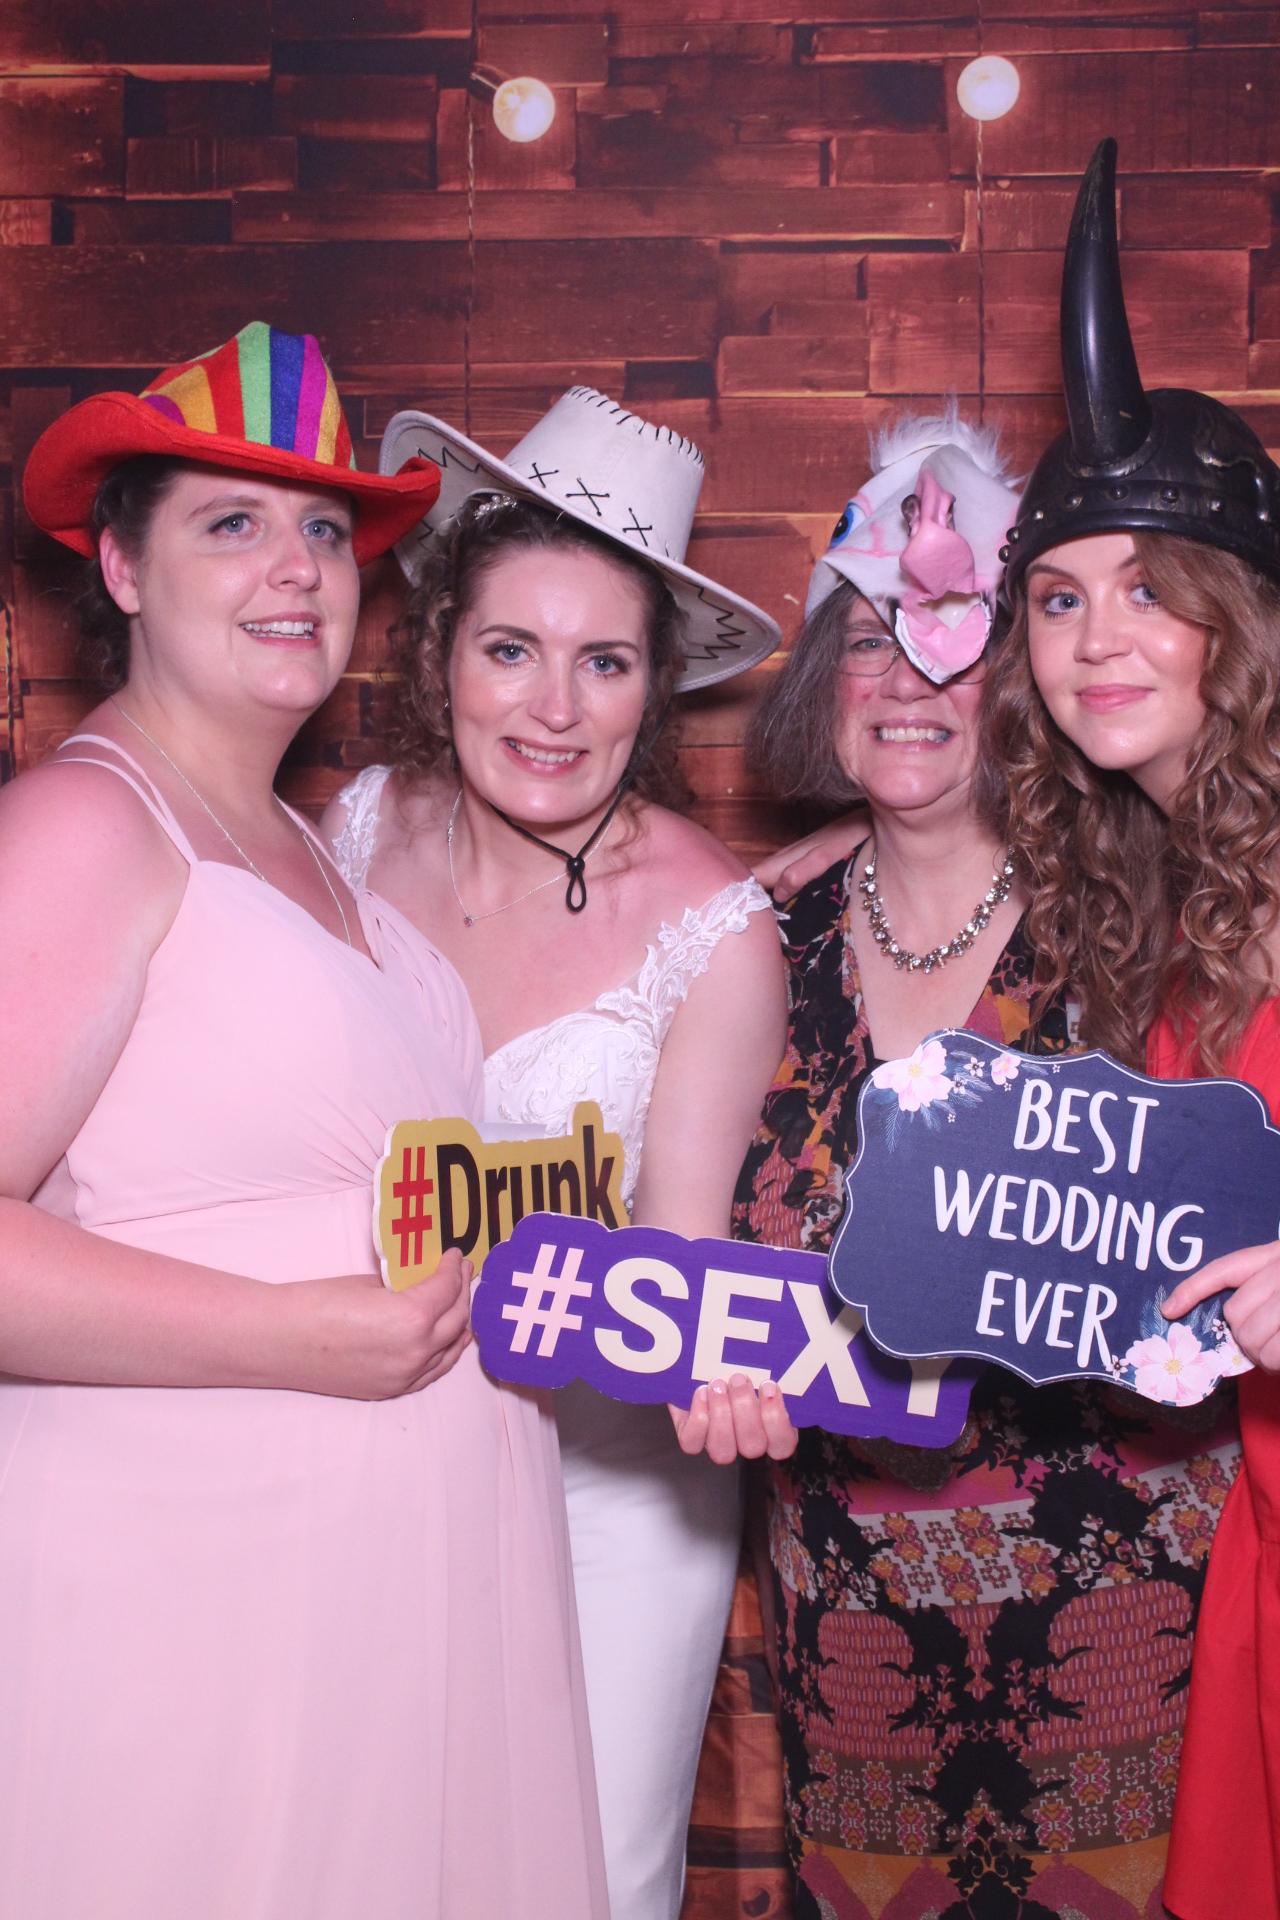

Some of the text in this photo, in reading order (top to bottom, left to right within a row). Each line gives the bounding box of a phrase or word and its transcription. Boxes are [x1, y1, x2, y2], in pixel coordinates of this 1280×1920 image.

[1013, 1078, 1160, 1174] BEST
[391, 1124, 619, 1268] #Drunk
[933, 1165, 1205, 1272] WEDDING
[975, 1270, 1118, 1368] EVER
